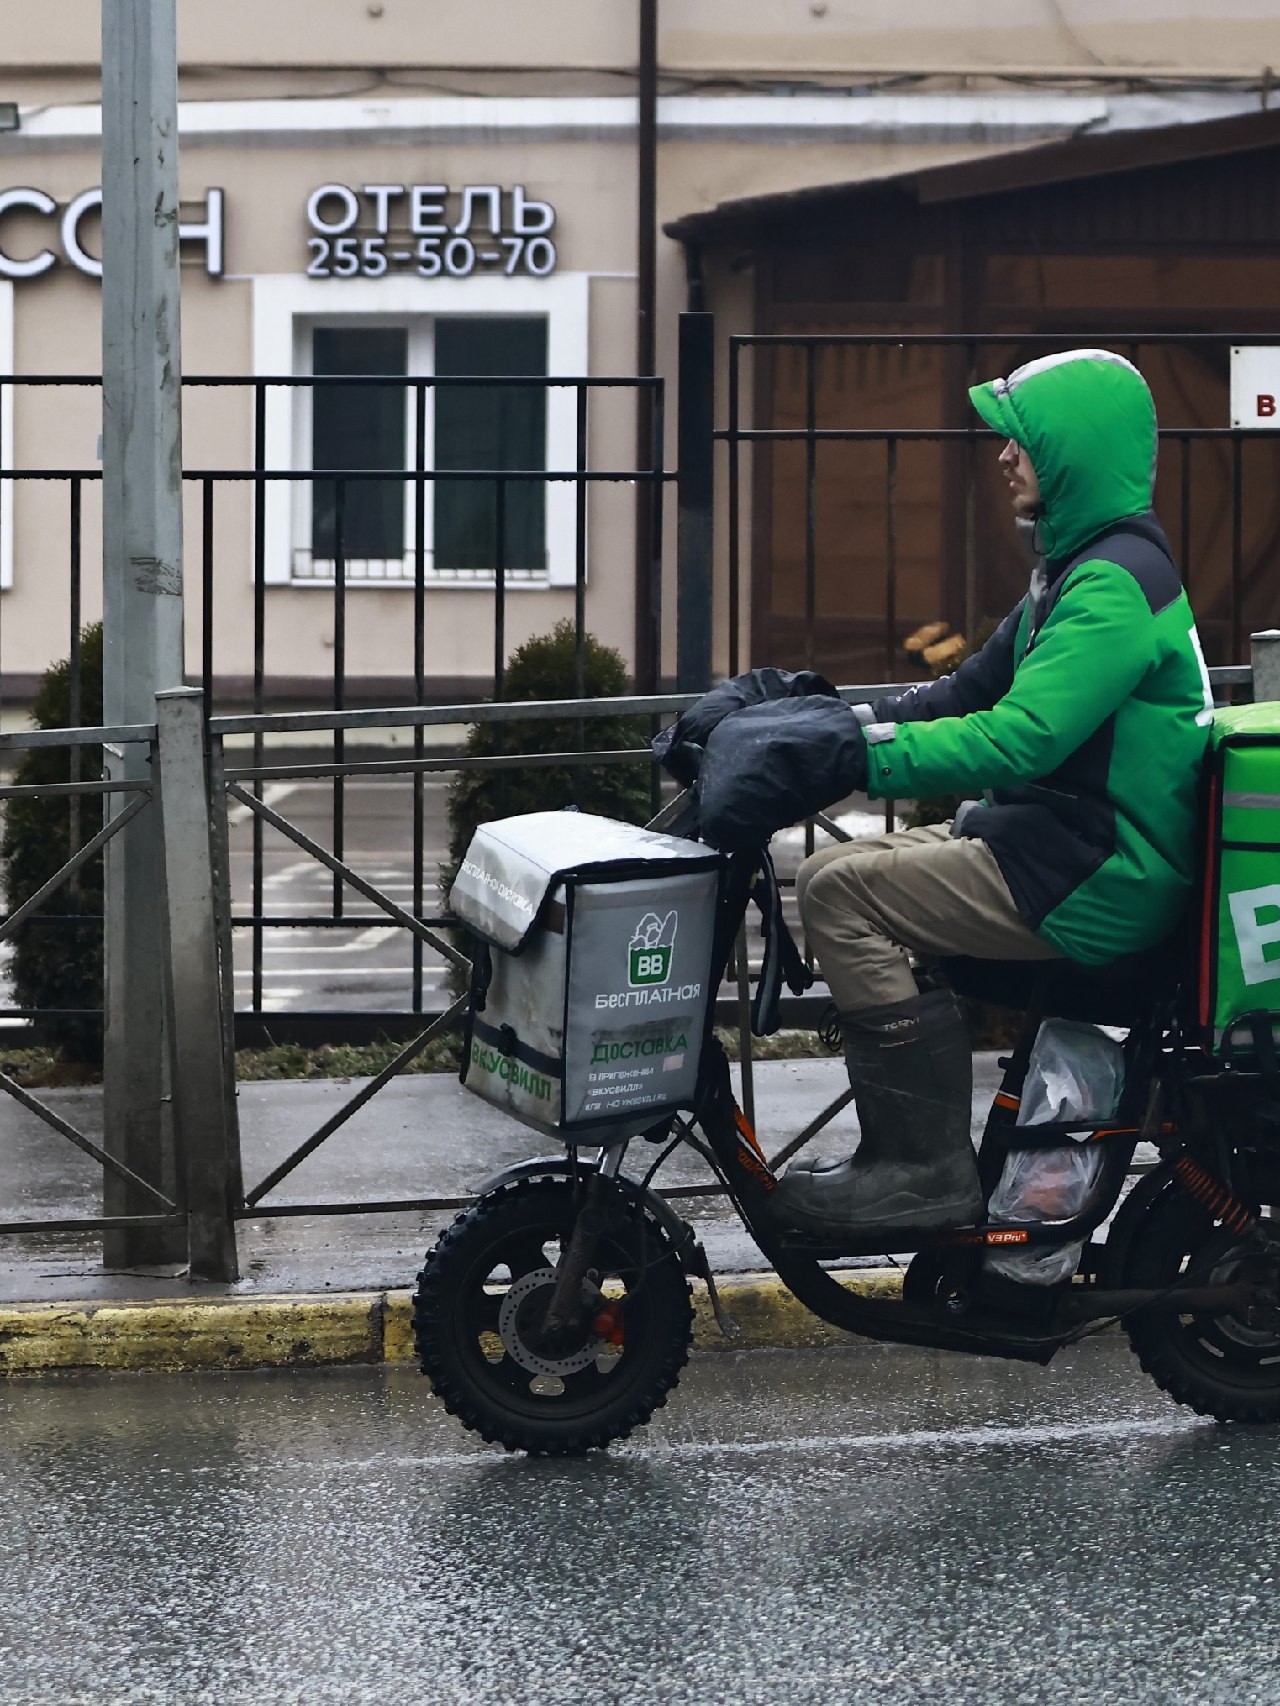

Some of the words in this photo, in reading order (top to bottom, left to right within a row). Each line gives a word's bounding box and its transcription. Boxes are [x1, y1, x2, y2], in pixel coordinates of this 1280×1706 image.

[306, 183, 558, 235] ОТЕЛЬ
[306, 237, 558, 277] 255-50-70
[1257, 394, 1277, 417] В
[636, 954, 664, 977] ВВ
[471, 1042, 552, 1102] ВКУСВИЛЛ
